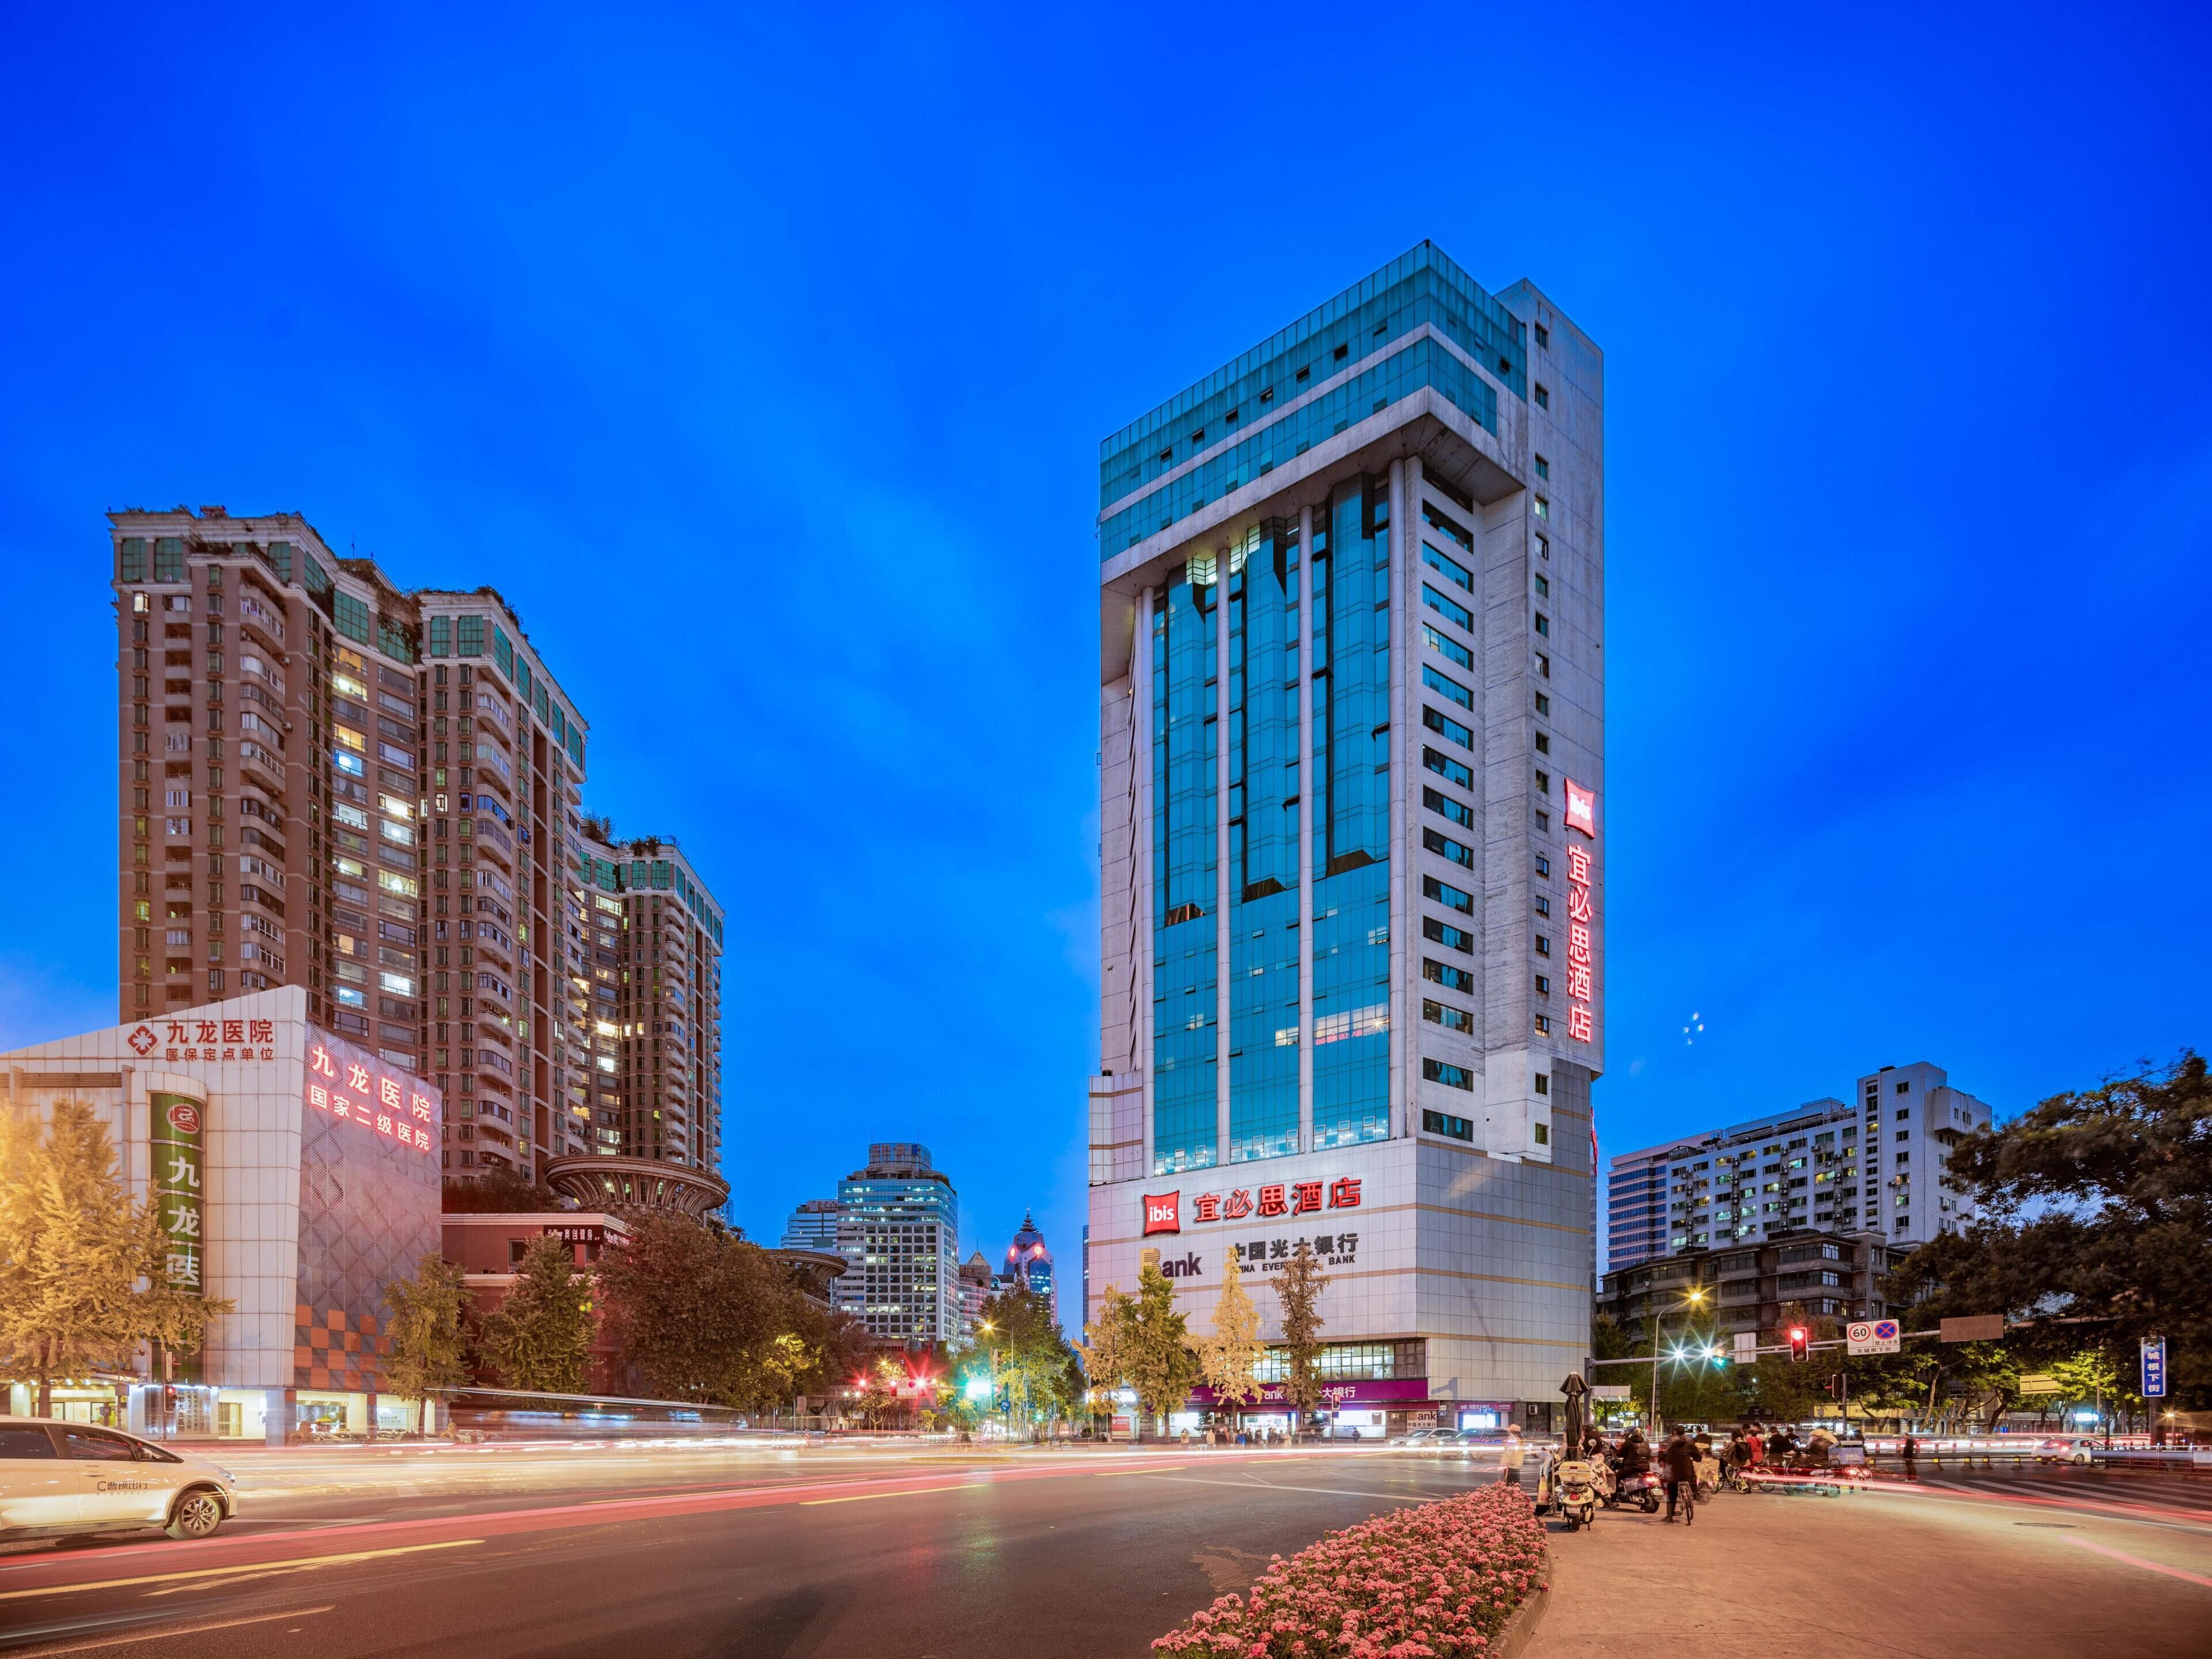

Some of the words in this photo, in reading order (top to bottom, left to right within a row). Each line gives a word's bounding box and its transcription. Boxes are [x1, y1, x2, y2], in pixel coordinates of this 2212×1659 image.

[1567, 845, 1592, 1043] 宜必思酒店
[167, 1019, 273, 1043] 九龙医院
[166, 1048, 274, 1061] 医保定点单位
[312, 1046, 430, 1123] 九龙医院
[311, 1084, 429, 1150] 国家二级医院
[1195, 1177, 1362, 1222] 宜必思酒店
[167, 1156, 200, 1286] 九龙医
[1149, 1205, 1175, 1222] ibis
[1239, 1264, 1255, 1273] INA
[1328, 1255, 1355, 1265] BANK
[1853, 1328, 1866, 1337] 60
[1264, 1391, 1283, 1400] ank
[1319, 1387, 1356, 1398] 大银行
